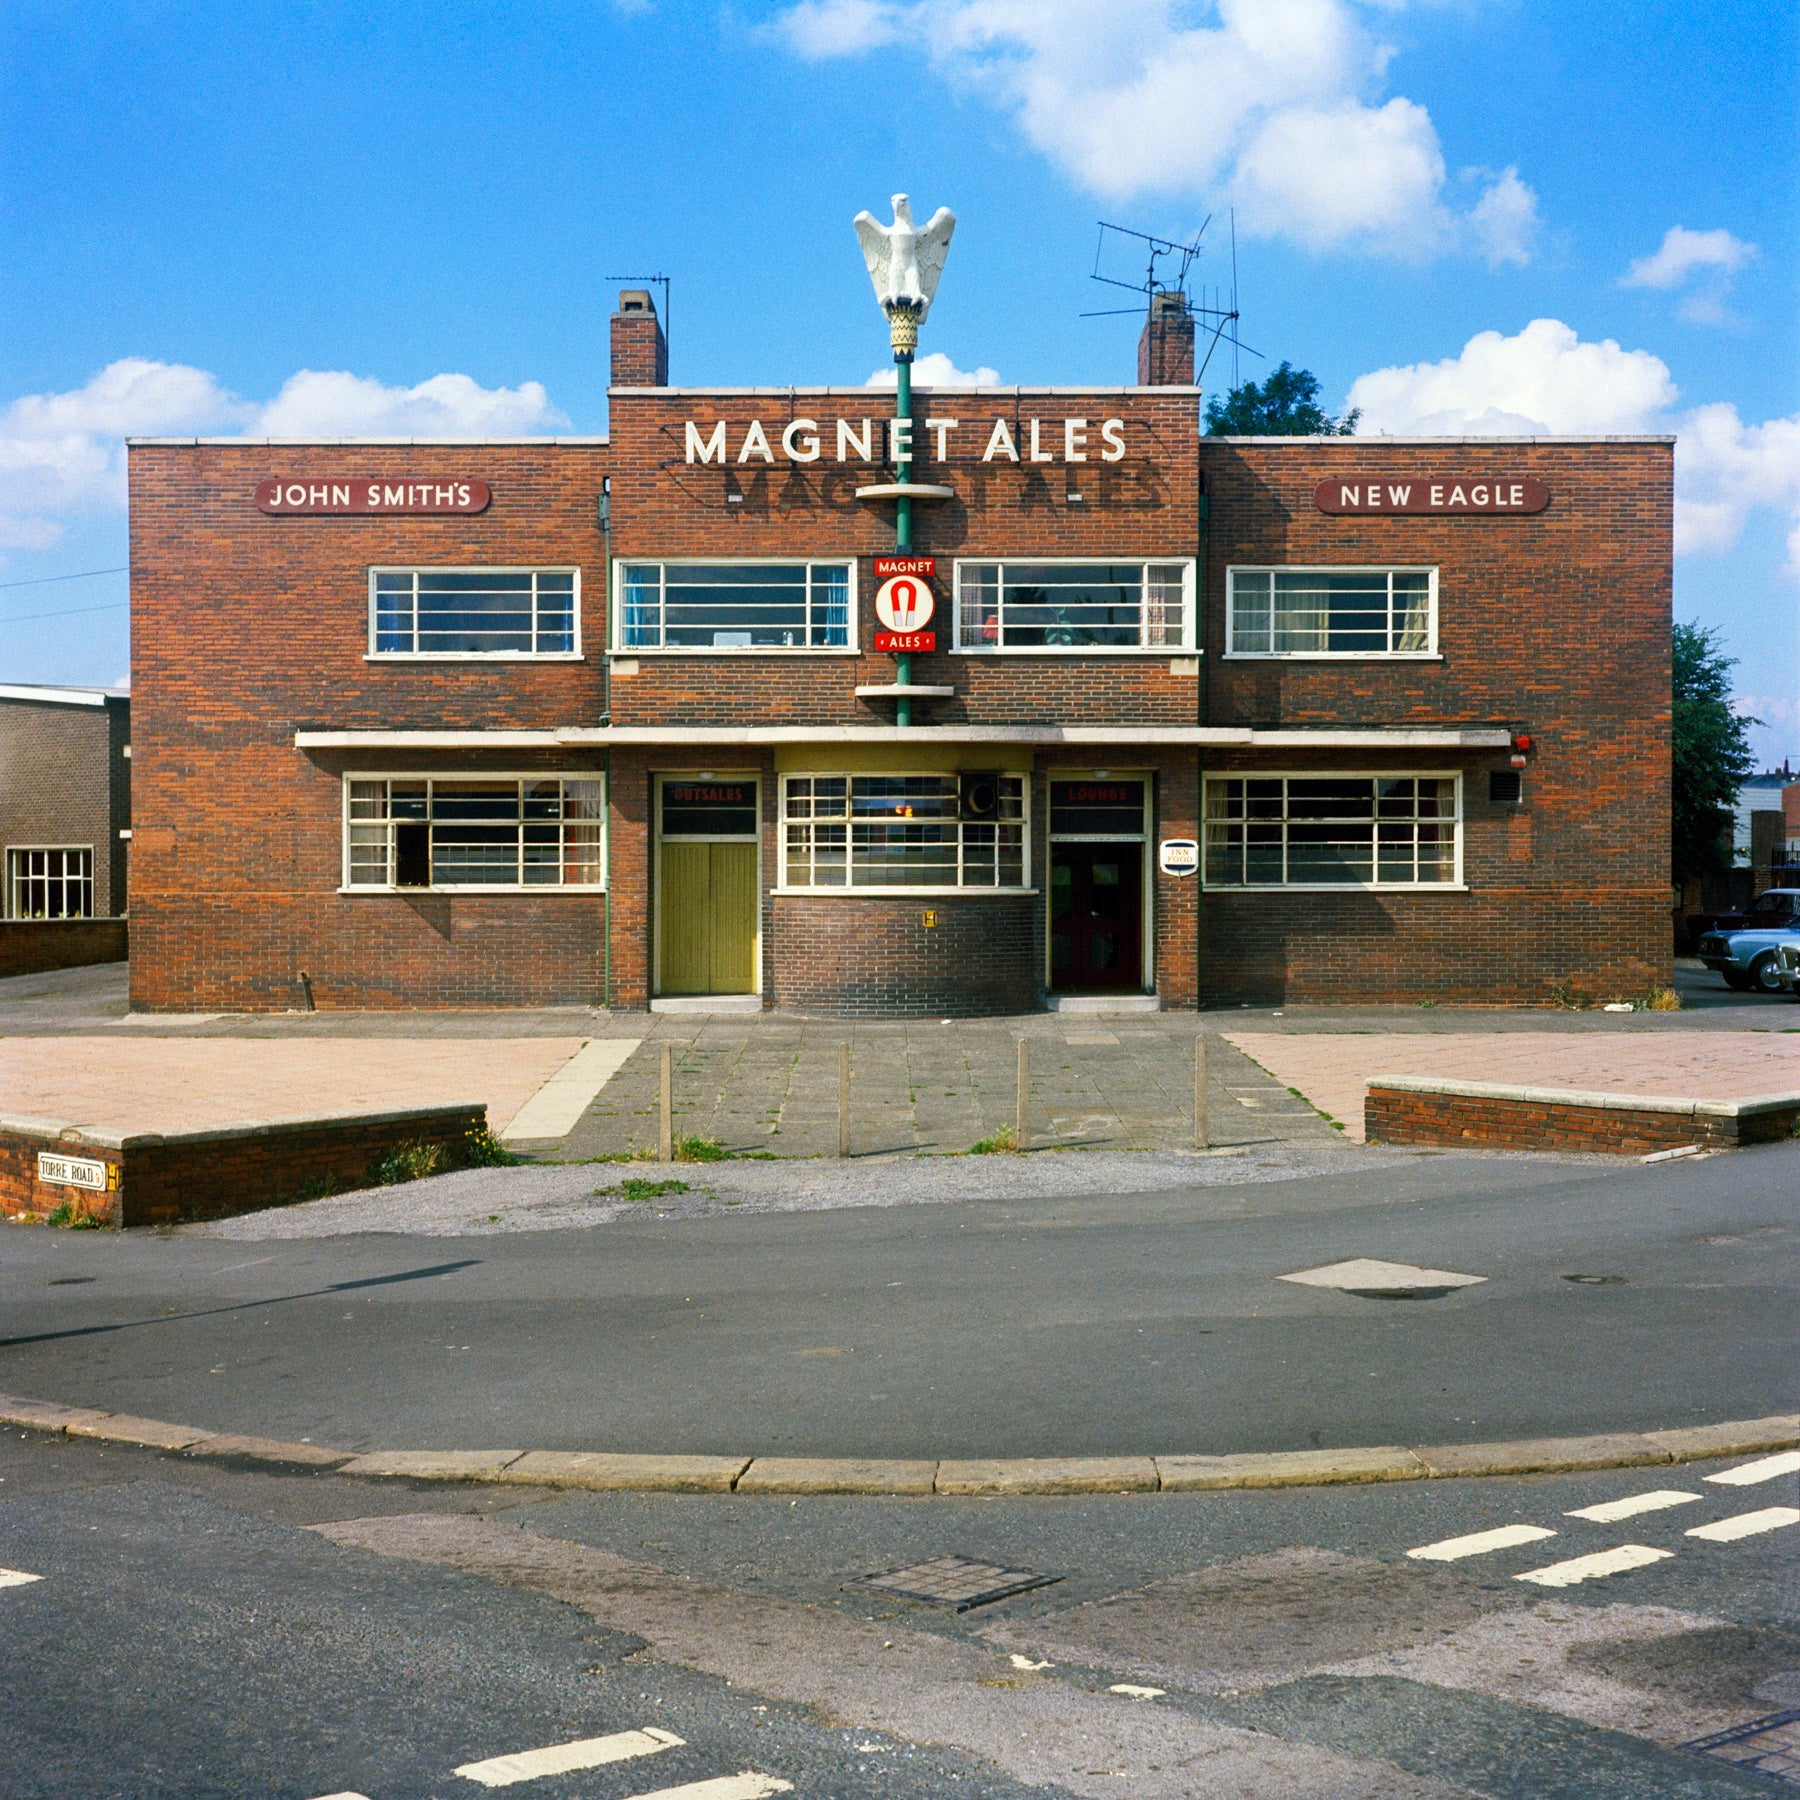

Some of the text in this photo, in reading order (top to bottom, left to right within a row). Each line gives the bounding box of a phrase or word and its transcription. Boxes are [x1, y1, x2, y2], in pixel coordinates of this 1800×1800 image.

[685, 418, 1126, 464] MAGNET ALES
[269, 482, 472, 507] JOHN SMITH'S
[1340, 484, 1525, 507] NEW EAGLE
[878, 561, 932, 572] MAGNET
[889, 636, 921, 648] ALES
[1067, 787, 1128, 801] LOUNGE
[1171, 848, 1189, 856] INN
[41, 1160, 68, 1179] TORRE
[71, 1165, 94, 1183] ROAD
[107, 1164, 119, 1190] H
